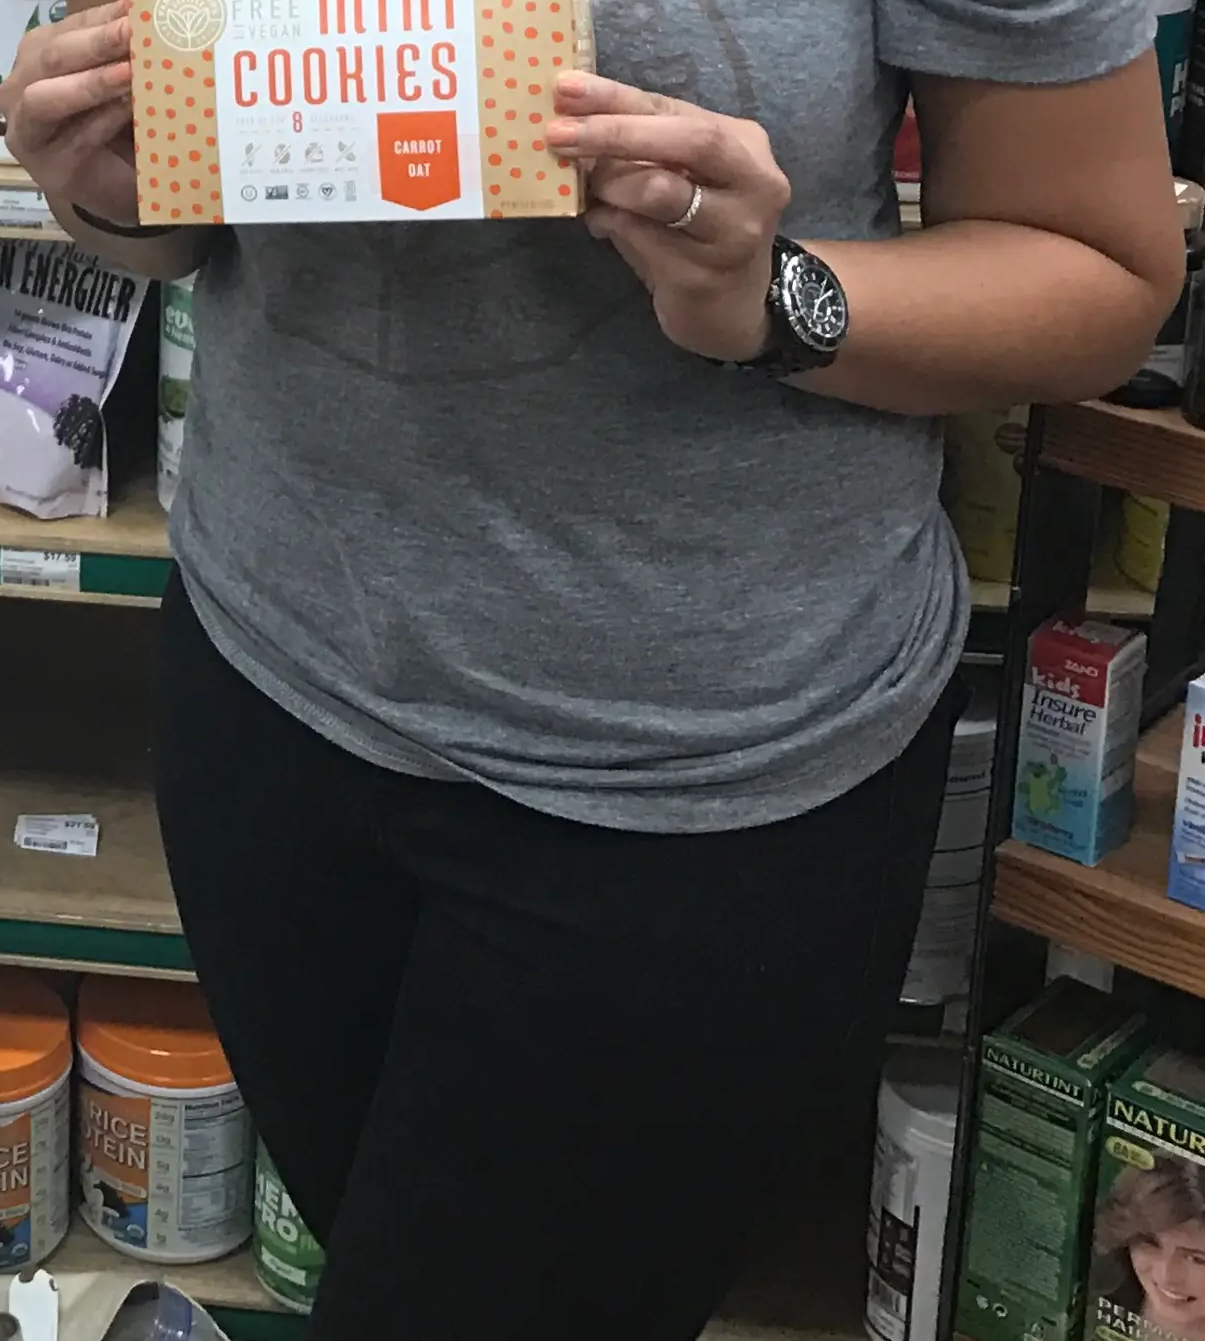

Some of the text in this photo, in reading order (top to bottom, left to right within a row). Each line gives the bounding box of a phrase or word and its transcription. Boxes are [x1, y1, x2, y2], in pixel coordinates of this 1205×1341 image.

[249, 24, 302, 40] VEGAN
[233, 42, 459, 108] COOKIES
[292, 110, 303, 133] 8
[394, 139, 442, 155] CARROT
[408, 167, 431, 179] OAT
[19, 248, 136, 324] ENERGIZER
[1032, 666, 1081, 700] kids
[1030, 687, 1097, 723] Insure
[1030, 706, 1087, 735] Herbal
[986, 1045, 1082, 1098] NATURTINT
[89, 1101, 147, 1148] RICE
[1114, 1099, 1205, 1157] NATUR
